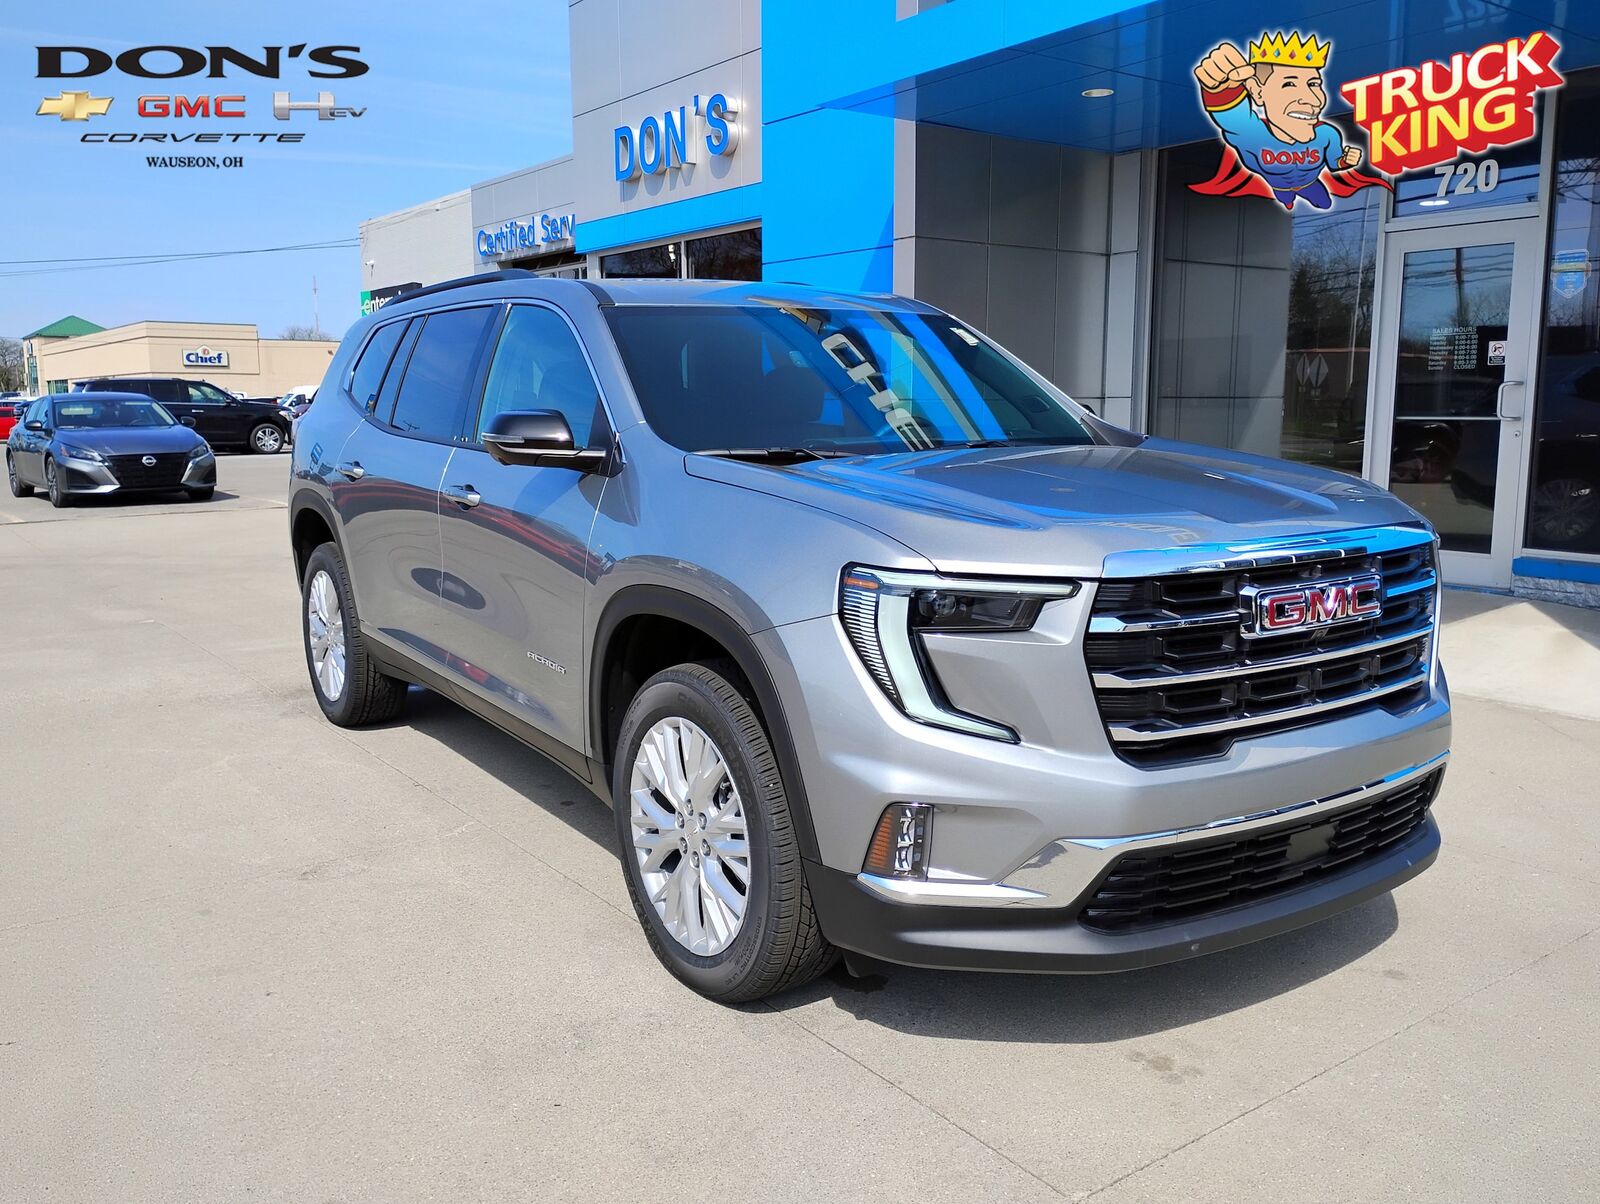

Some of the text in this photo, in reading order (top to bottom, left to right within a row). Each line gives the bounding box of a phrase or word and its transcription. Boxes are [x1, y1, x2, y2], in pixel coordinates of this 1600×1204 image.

[614, 93, 732, 182] DON'S
[1435, 159, 1499, 198] 720
[478, 213, 577, 256] Certified Serv
[185, 352, 223, 364] Chief
[1264, 579, 1380, 629] GMC
